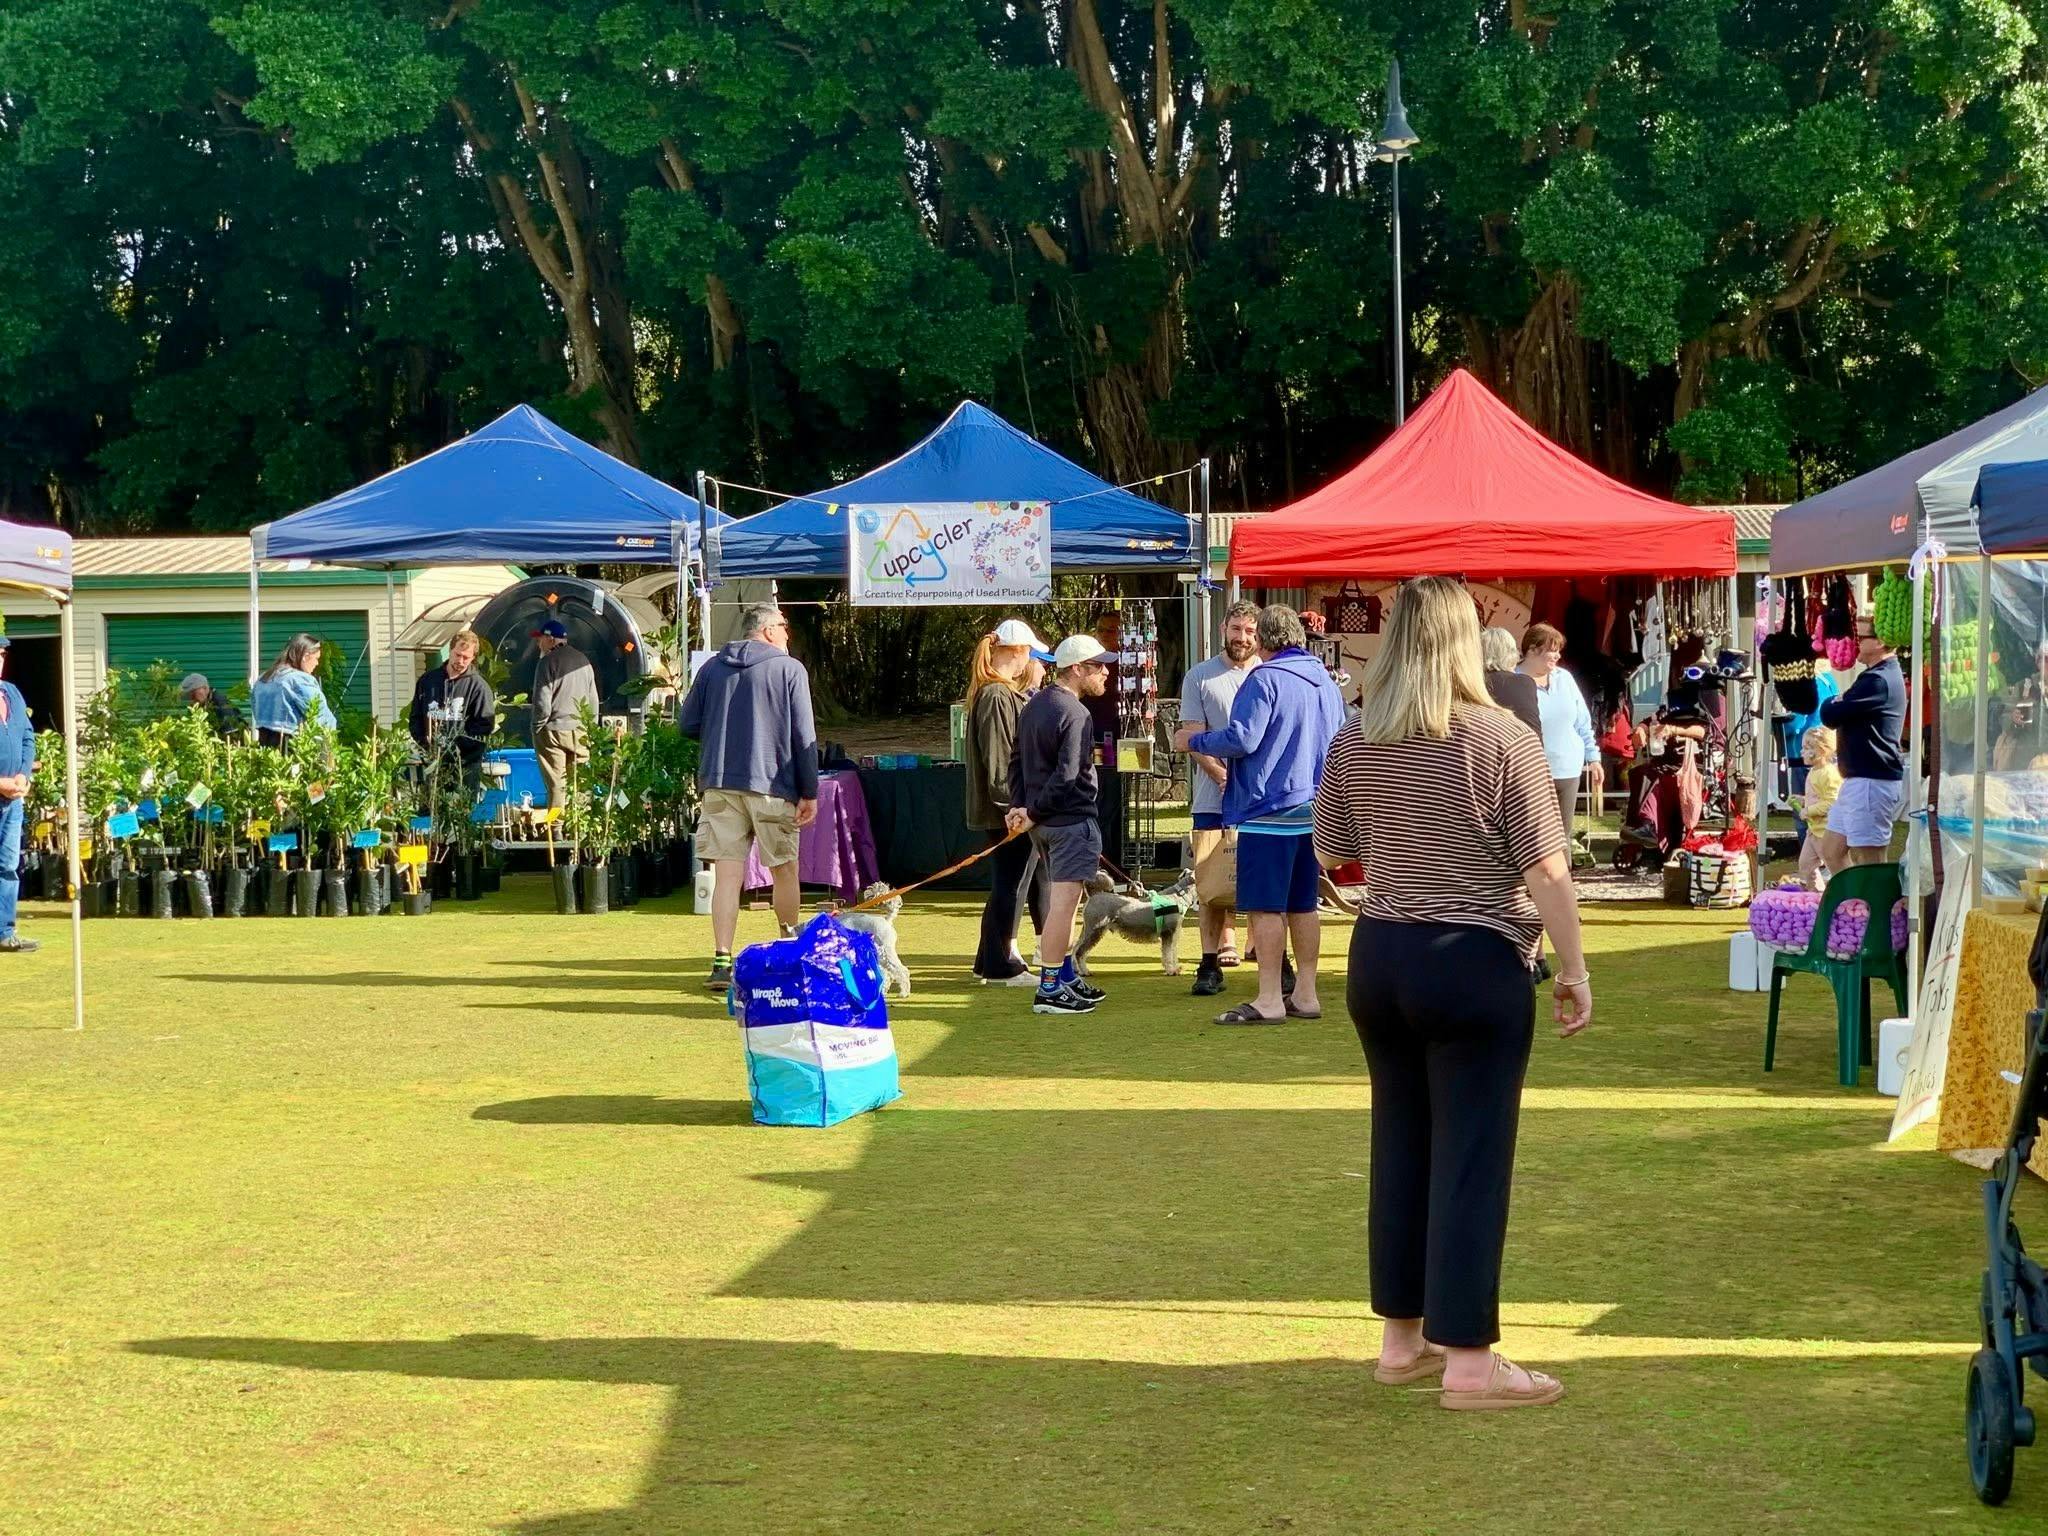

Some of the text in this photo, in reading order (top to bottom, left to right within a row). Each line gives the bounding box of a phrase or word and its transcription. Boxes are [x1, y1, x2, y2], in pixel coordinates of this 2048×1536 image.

[884, 518, 973, 577] upcycler
[864, 587, 1035, 600] Creative Repurposing of Used Plastic
[771, 998, 799, 1008] Move
[829, 1039, 867, 1052] MOVING
